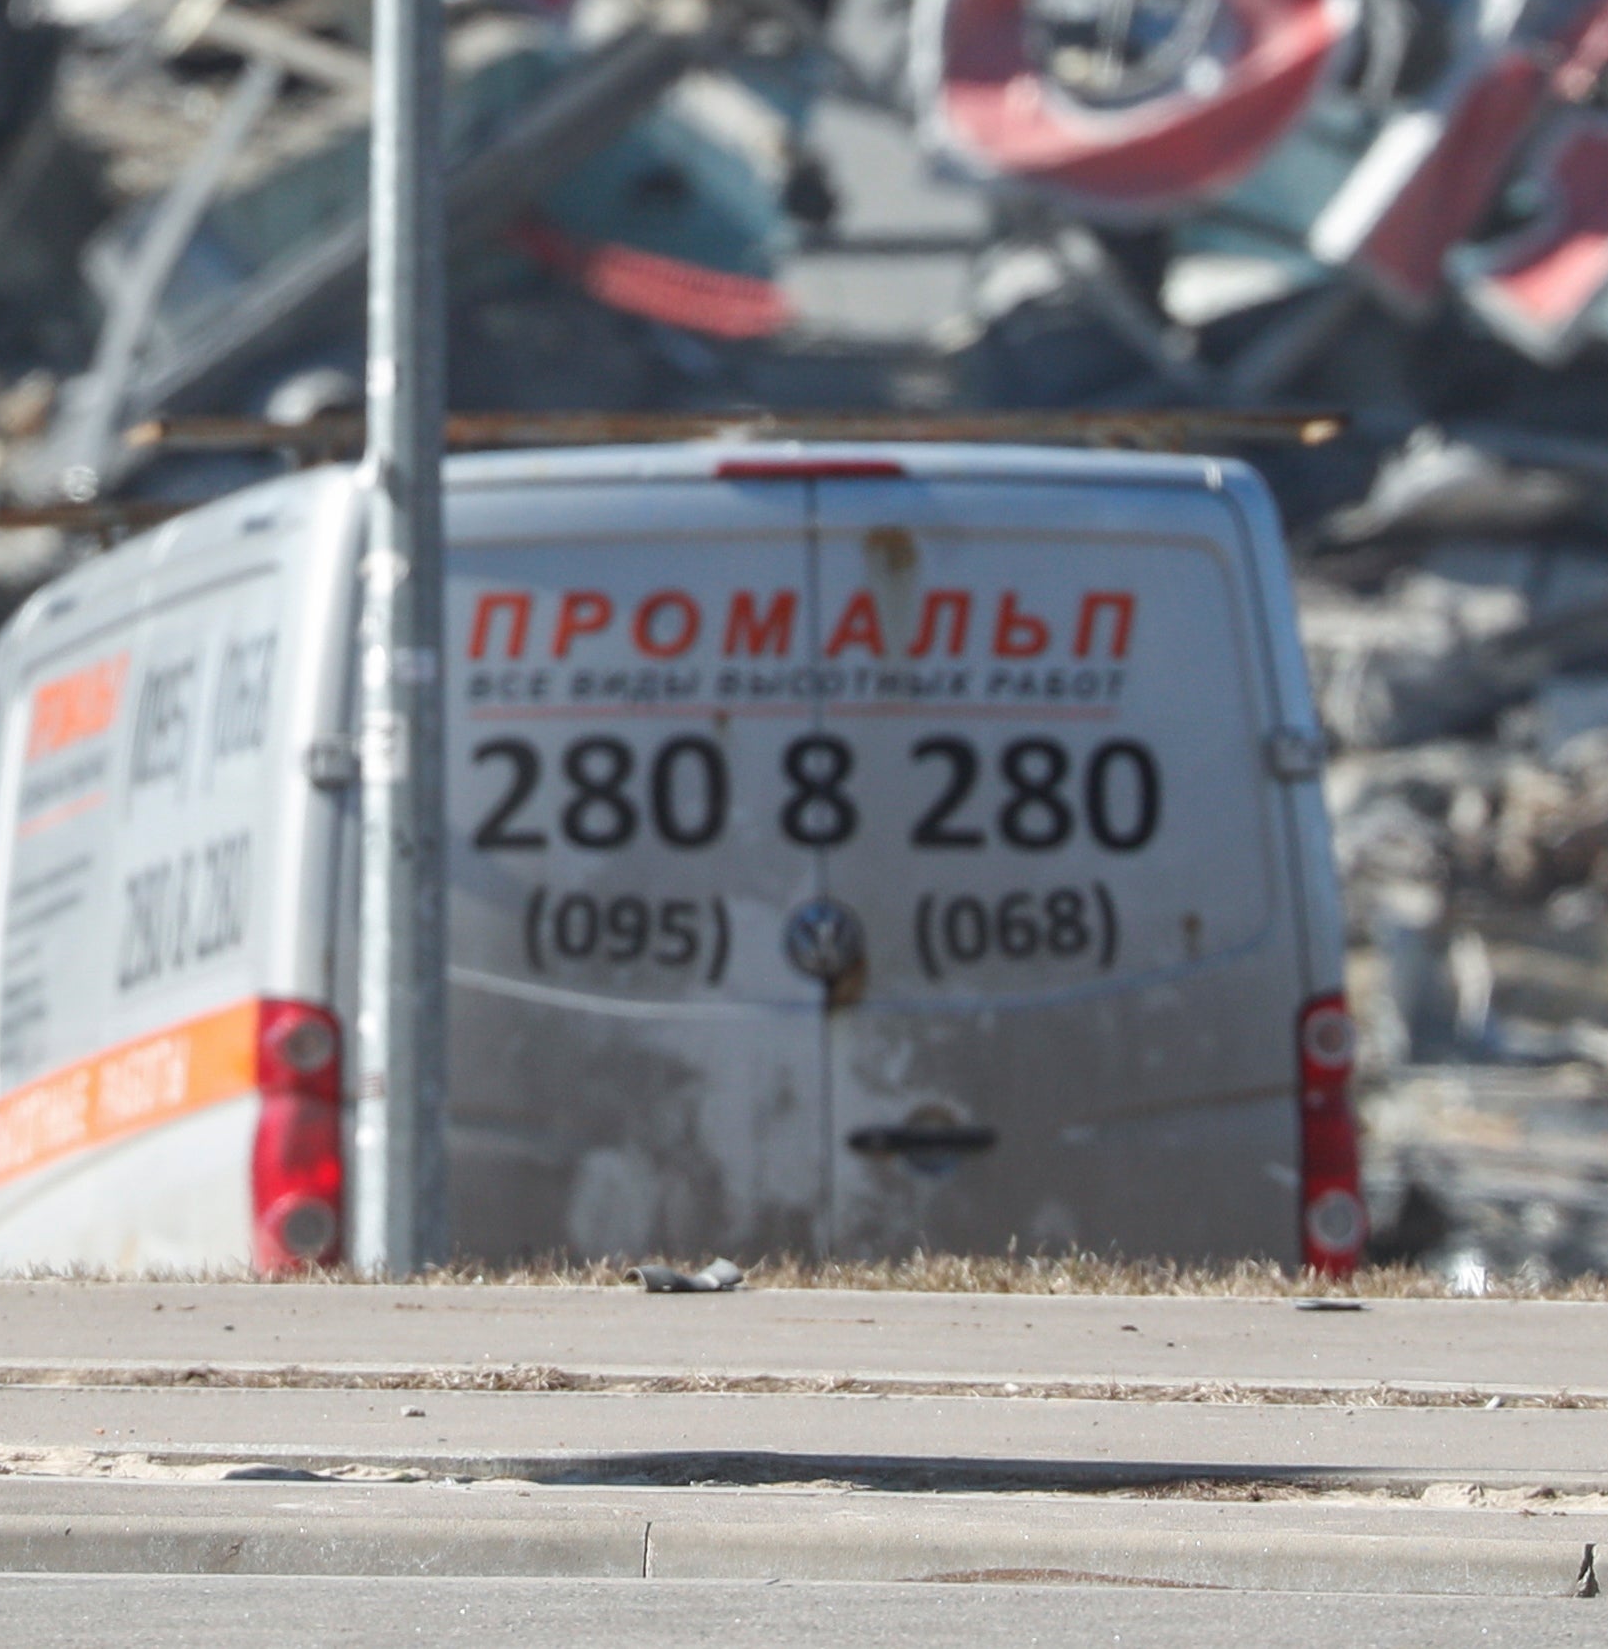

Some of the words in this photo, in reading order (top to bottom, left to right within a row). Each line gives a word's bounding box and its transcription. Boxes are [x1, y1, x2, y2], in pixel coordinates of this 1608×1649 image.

[465, 588, 1139, 660] ПРОМАЛЬП
[468, 667, 552, 702] ВСЕ
[568, 667, 699, 705] ВИДЫ
[714, 665, 973, 703] ВЫСОТНЫХ
[985, 667, 1126, 702] РАБОТ
[471, 733, 730, 852] 280
[778, 733, 859, 852] 8
[909, 733, 1163, 853] 280
[523, 888, 730, 984] (095)
[913, 884, 1118, 970] (068)
